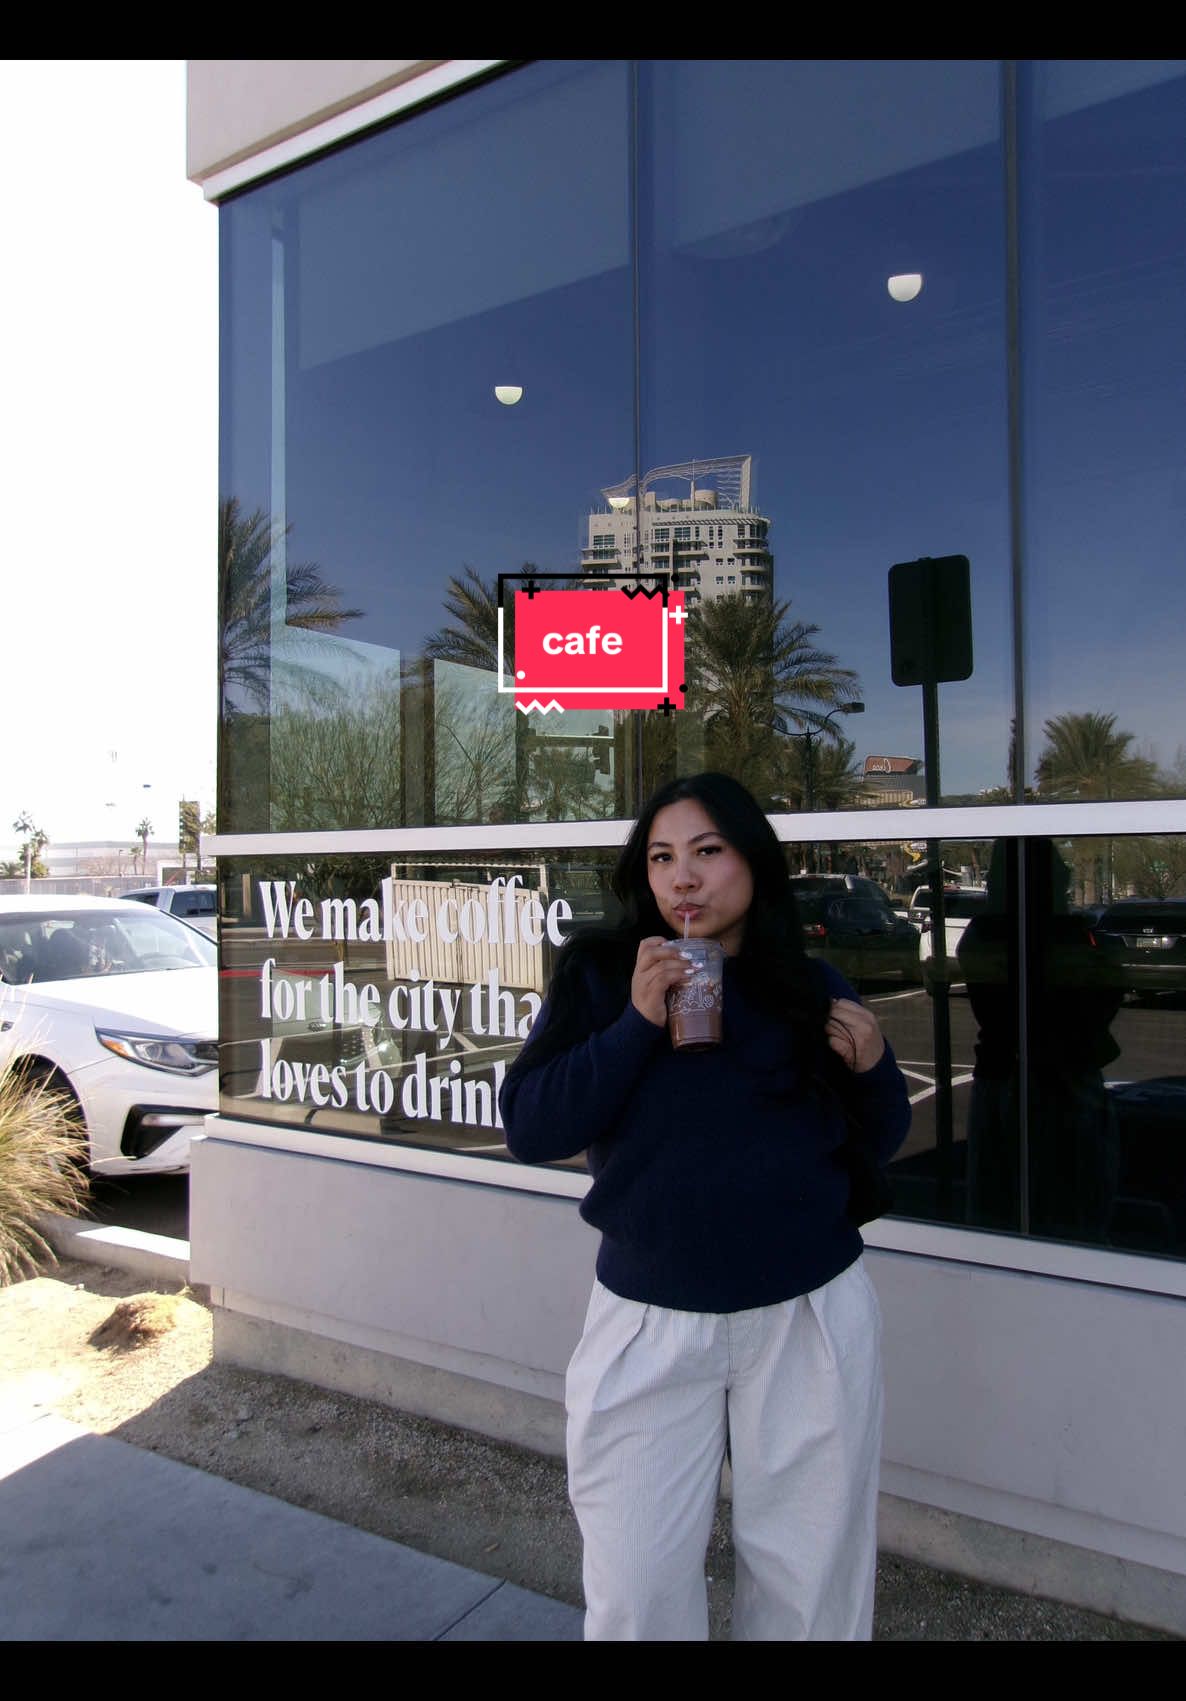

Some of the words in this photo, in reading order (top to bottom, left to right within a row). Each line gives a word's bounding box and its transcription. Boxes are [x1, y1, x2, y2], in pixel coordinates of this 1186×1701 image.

[259, 880, 314, 939] We
[320, 876, 429, 942] make
[438, 875, 573, 947] coffee
[259, 958, 312, 1021] for
[319, 961, 381, 1027] the
[388, 968, 461, 1050] city
[469, 968, 542, 1039] tha
[260, 1038, 348, 1109] loves
[355, 1060, 394, 1114] to
